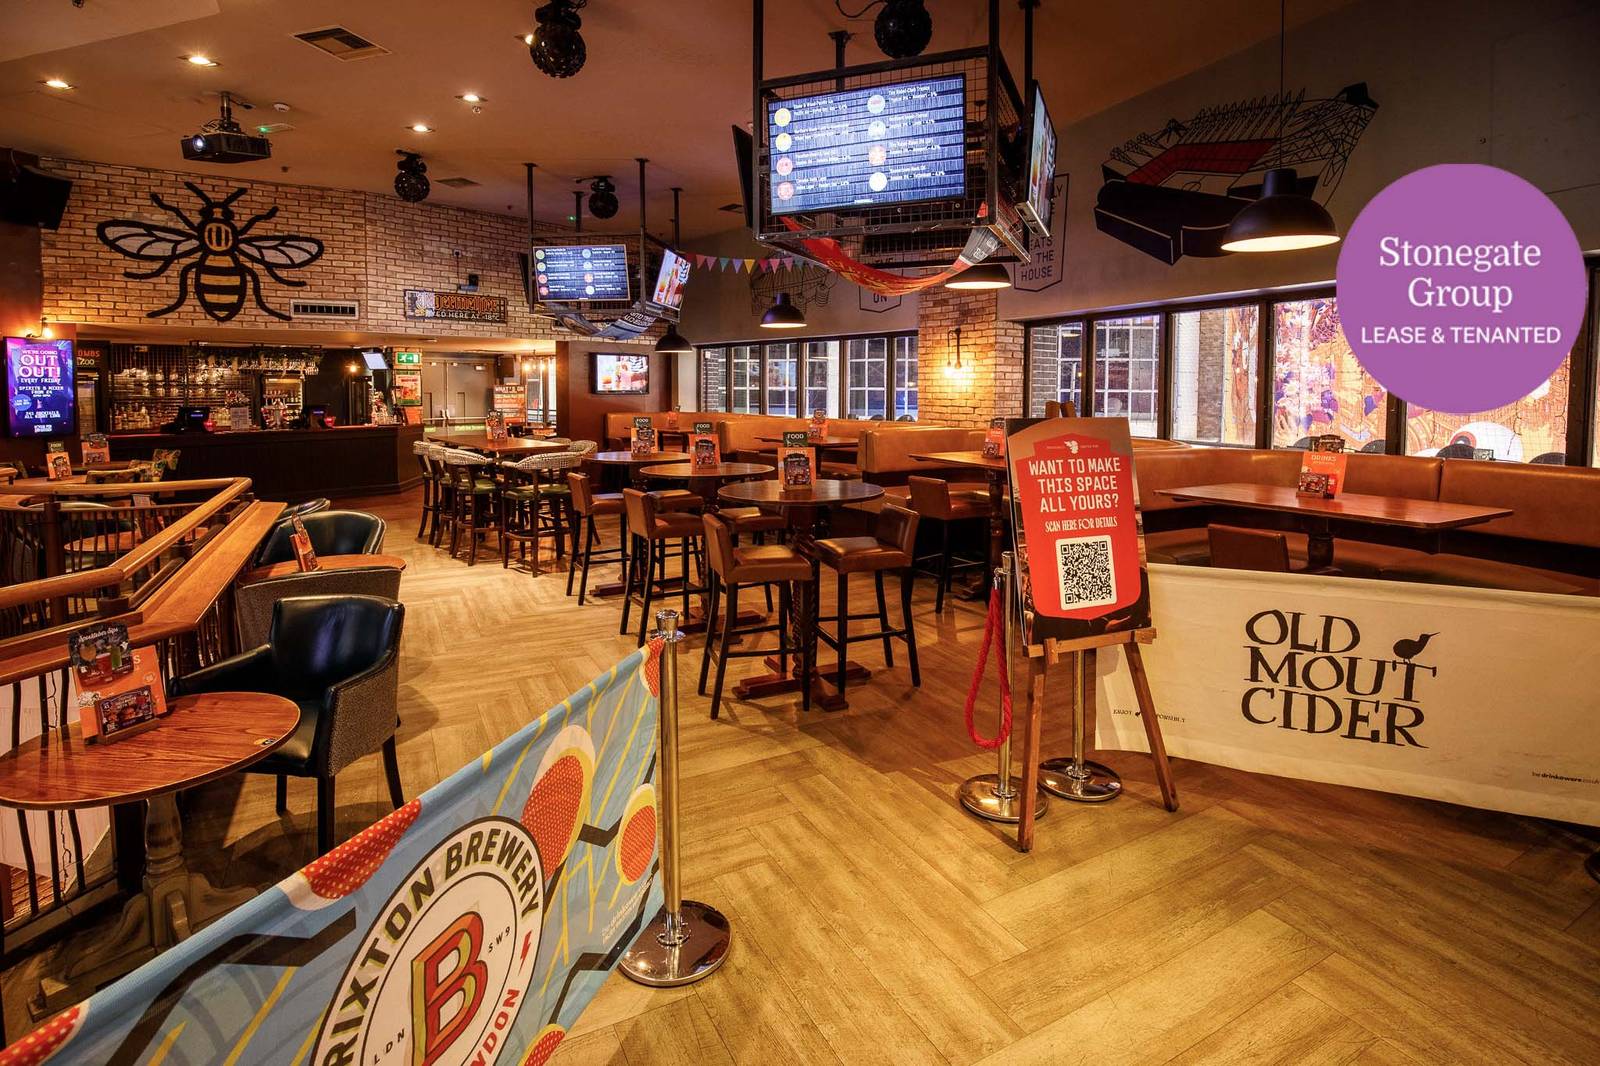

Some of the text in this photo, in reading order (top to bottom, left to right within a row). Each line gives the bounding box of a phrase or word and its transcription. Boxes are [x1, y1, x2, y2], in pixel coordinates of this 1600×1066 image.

[1035, 249, 1055, 265] THE
[1020, 265, 1053, 281] HOUSE
[448, 311, 469, 319] HERE
[20, 354, 58, 366] OUT
[19, 366, 61, 378] OUT!
[40, 377, 61, 385] FRIDAY
[1028, 457, 1121, 476] WANT TO MAKE
[1037, 475, 1118, 494] THIS SPACE
[1040, 493, 1119, 513] ALL YOURS?
[1044, 515, 1118, 533] SCAN HERE FOR DETAILS
[1245, 609, 1361, 654] OLD
[1243, 645, 1437, 703] MOUT
[1241, 687, 1430, 748] CIDER
[322, 866, 436, 1066] RIXTON
[445, 828, 539, 918] BREWERY
[487, 926, 511, 953] SW9
[470, 989, 521, 1066] NDON
[373, 1028, 405, 1065] LDN
